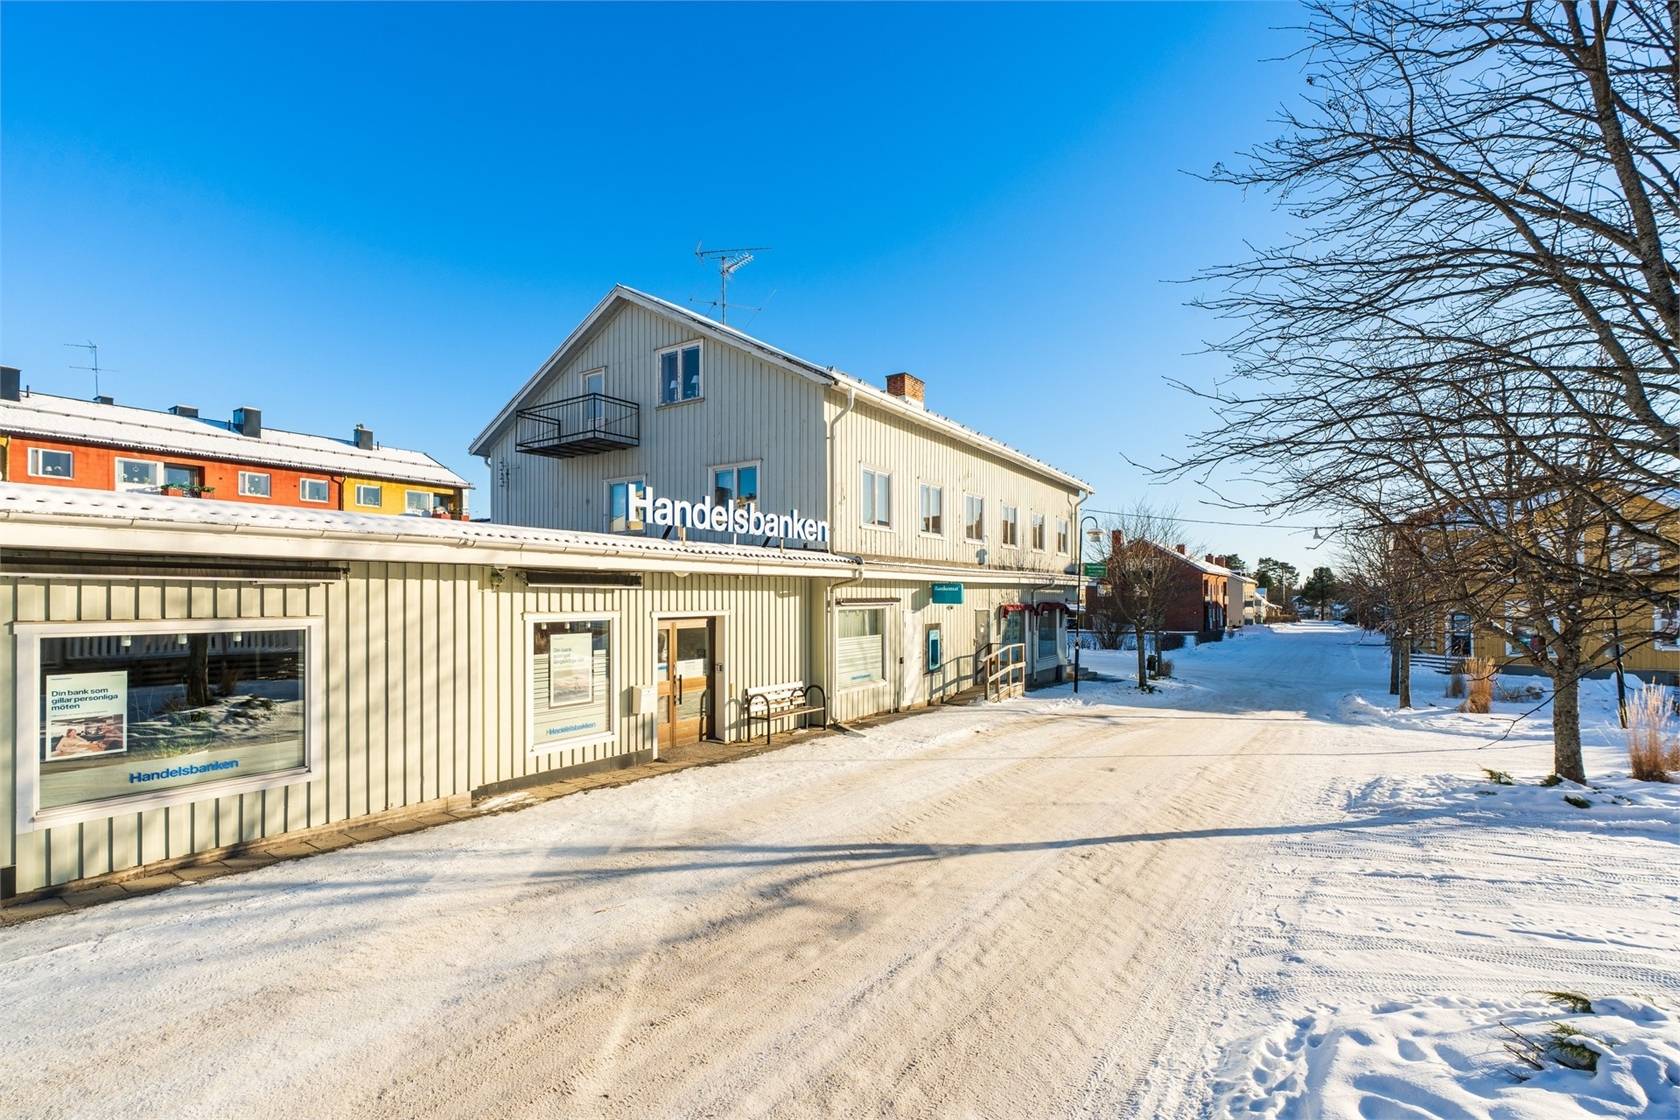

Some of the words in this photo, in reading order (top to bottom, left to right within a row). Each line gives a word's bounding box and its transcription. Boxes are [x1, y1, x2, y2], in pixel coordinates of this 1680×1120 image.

[628, 484, 830, 542] Handelsbanken
[51, 696, 72, 705] gillar
[73, 694, 118, 703] personliga
[51, 703, 80, 711] möten
[129, 760, 239, 783] Handelsbanken
